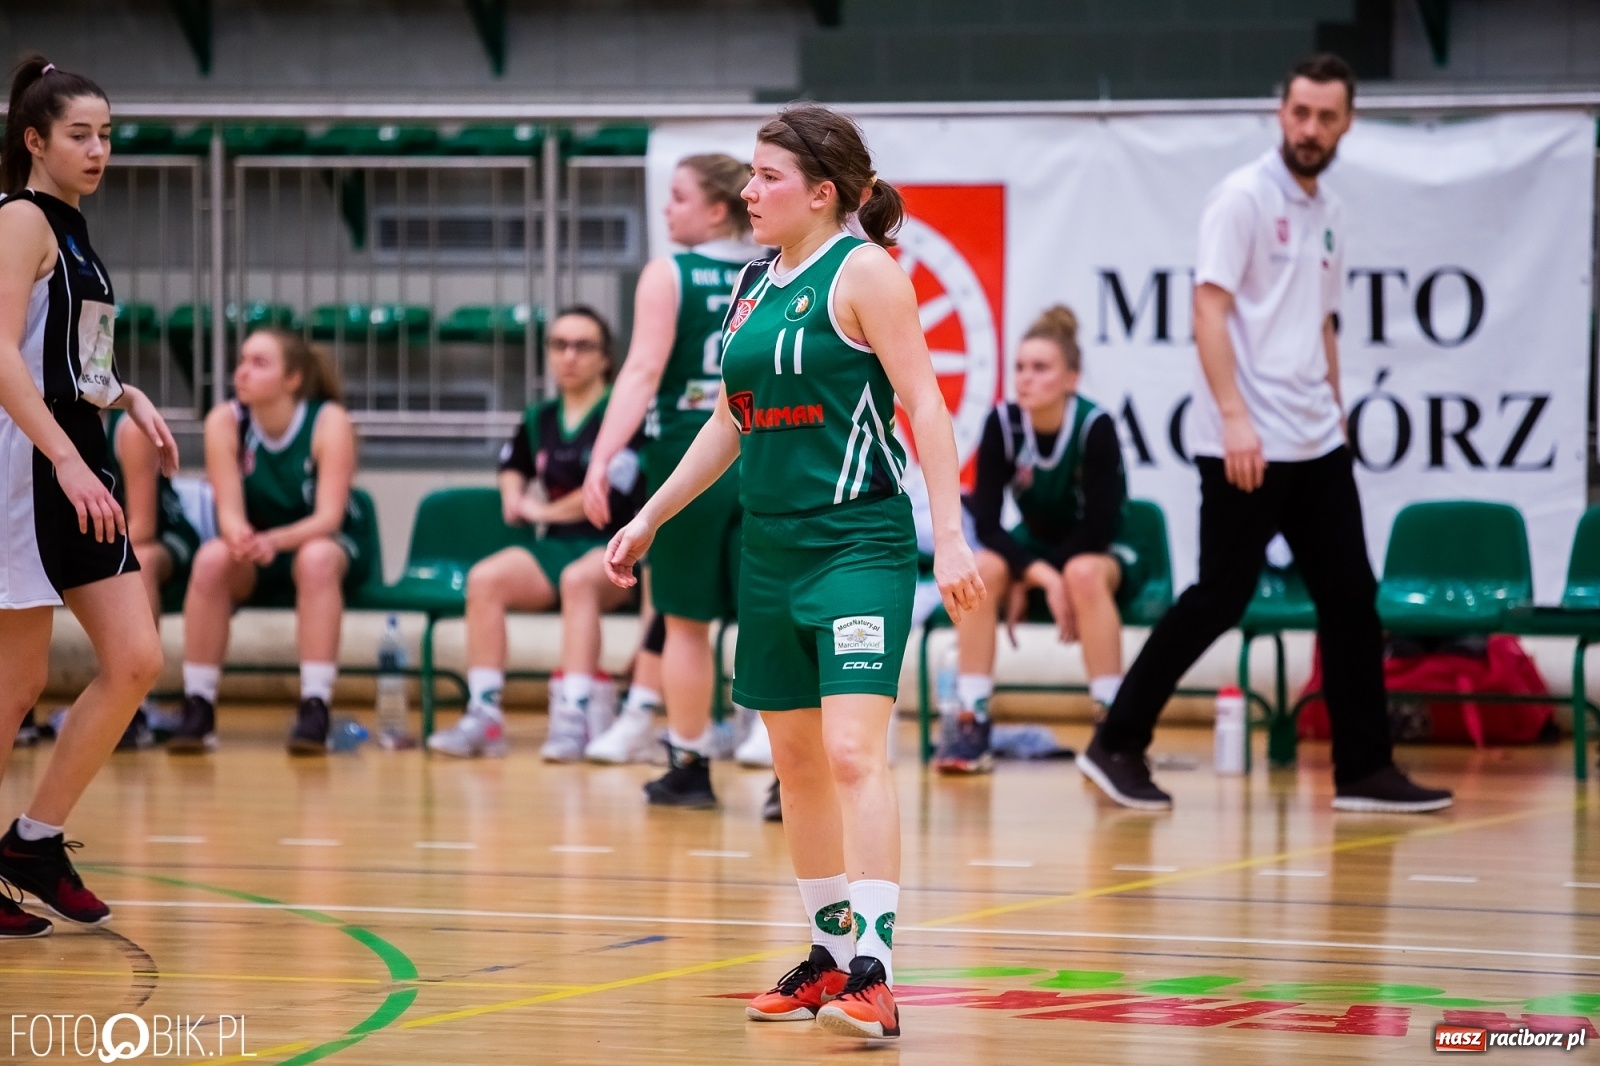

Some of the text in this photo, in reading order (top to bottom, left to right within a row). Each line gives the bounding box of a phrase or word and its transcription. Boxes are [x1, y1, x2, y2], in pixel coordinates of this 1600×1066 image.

[1093, 265, 1486, 347] MTO
[774, 327, 804, 375] 11
[837, 619, 880, 632] MoceNatury.pl
[842, 661, 883, 670] COLO
